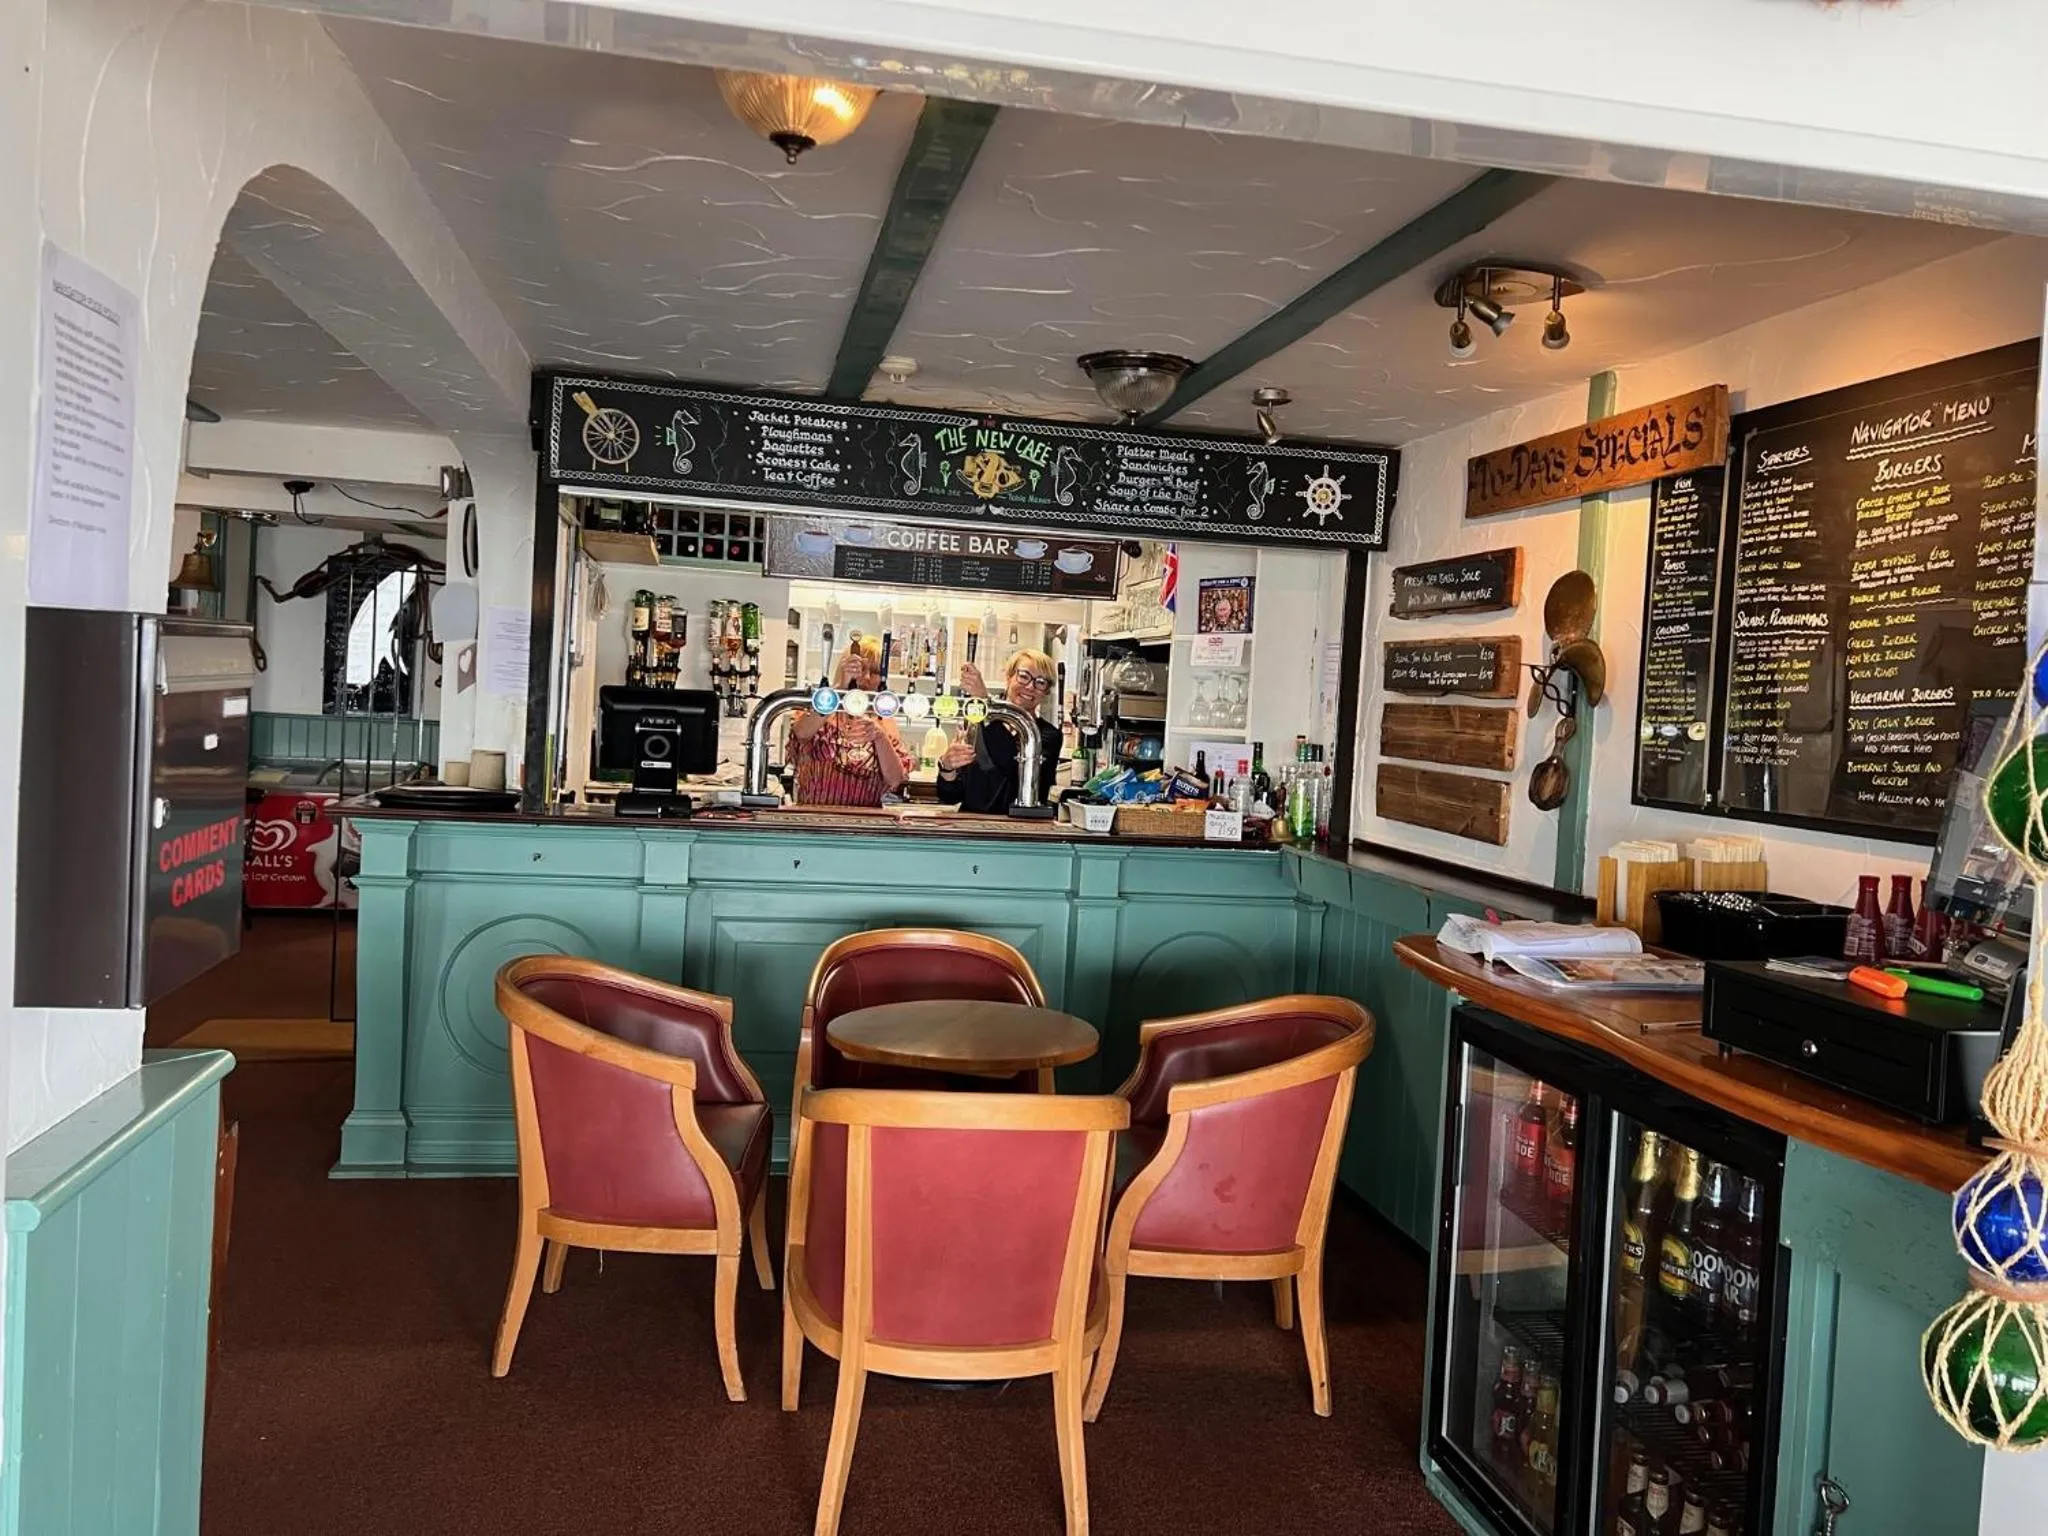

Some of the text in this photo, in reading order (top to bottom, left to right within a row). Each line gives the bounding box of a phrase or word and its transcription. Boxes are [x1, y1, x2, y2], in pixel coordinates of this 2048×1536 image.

[748, 411, 849, 431] Jacket Potatoes
[1851, 395, 1991, 446] NAVIGATOR MENU
[761, 426, 833, 443] Ploughmans
[934, 427, 968, 451] THE
[975, 429, 1015, 449] NEW
[762, 440, 825, 456] Baguettes
[1117, 445, 1195, 463] Platter Meals
[810, 459, 841, 472] Cake
[1120, 458, 1188, 476] Sandwiches
[1874, 453, 1944, 483] BURGERS
[762, 467, 786, 481] Tea
[795, 474, 836, 489] Coffee
[1109, 485, 1197, 507] Soup of the Day
[1094, 499, 1130, 513] Share
[1143, 503, 1177, 515] Combo
[1180, 506, 1197, 519] for
[1200, 505, 1209, 517] 2
[888, 531, 1010, 556] COFFEE BAR
[1850, 689, 1906, 705] VEGETARIAN
[159, 815, 240, 872] COMMENT
[246, 855, 293, 867] ALL'S
[171, 859, 226, 909] CARDS
